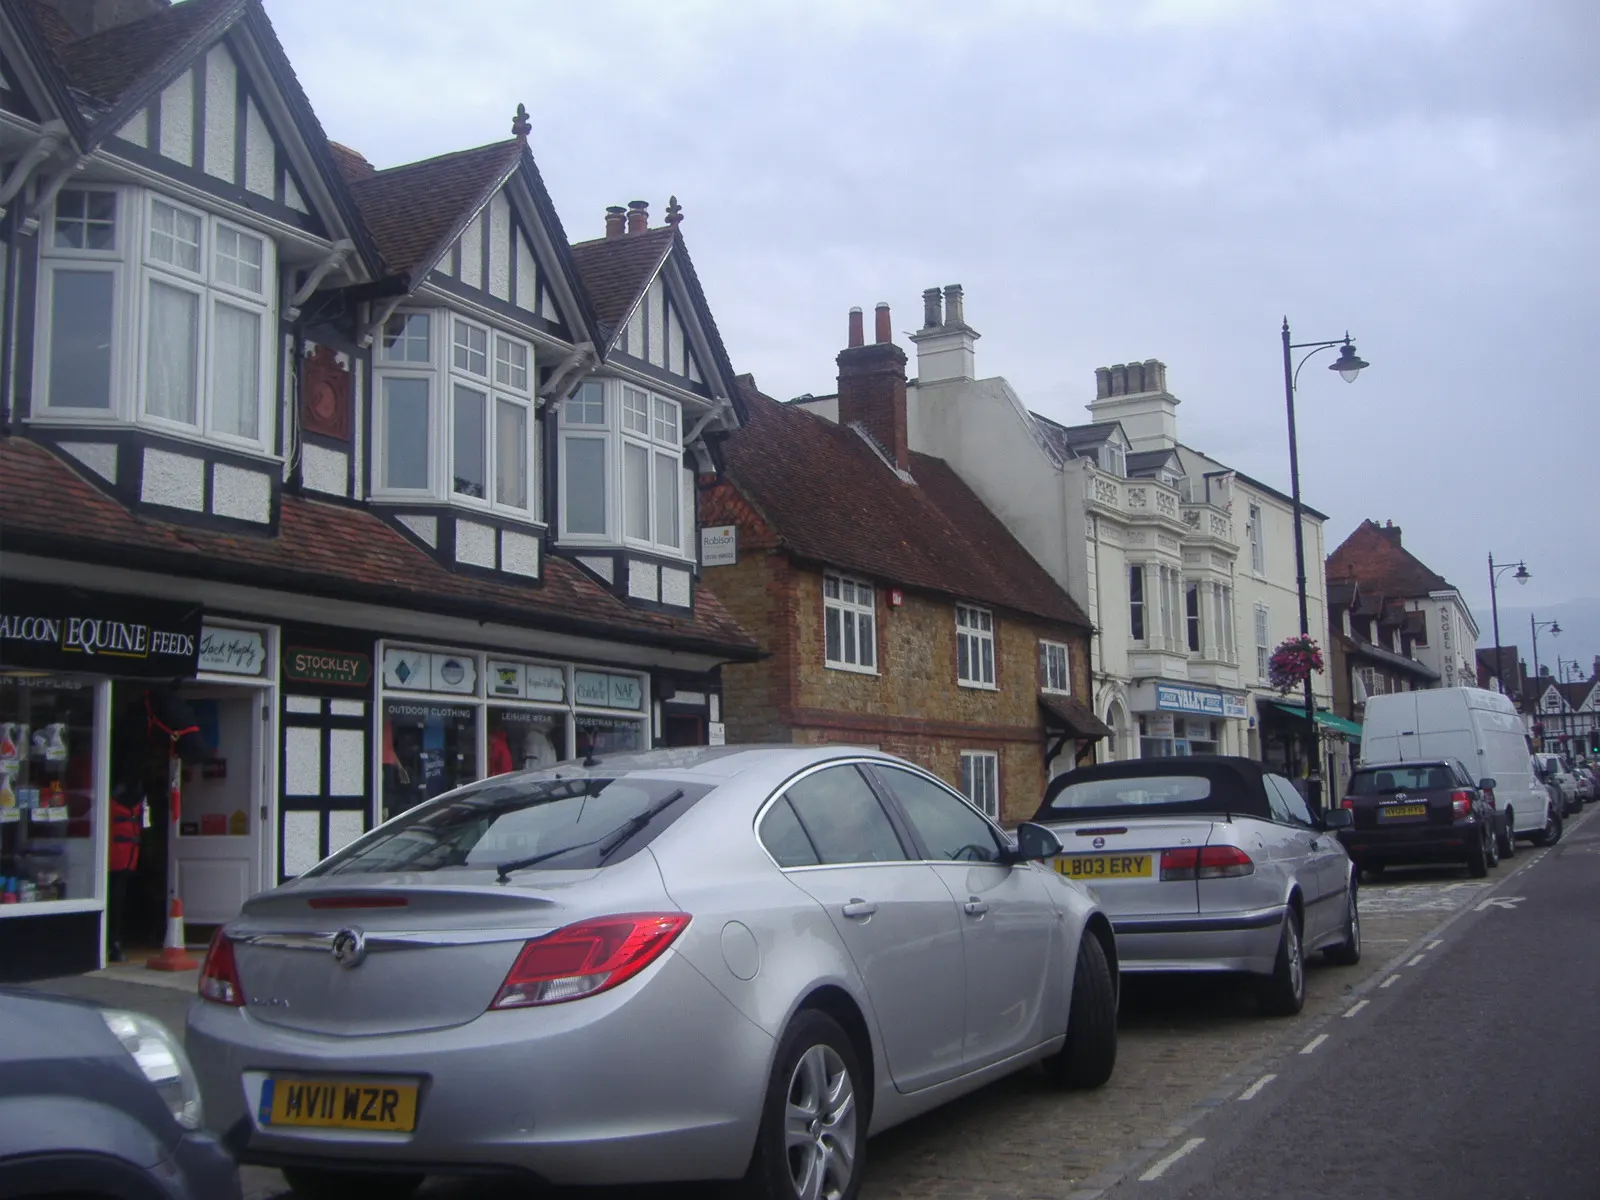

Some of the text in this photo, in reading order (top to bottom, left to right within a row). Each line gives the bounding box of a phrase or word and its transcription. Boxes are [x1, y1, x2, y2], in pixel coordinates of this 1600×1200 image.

[0, 613, 195, 656] ALCON EQUINE FEEDS
[1439, 605, 1451, 650] ANGEL
[295, 654, 359, 676] STOCKLEY
[17, 676, 82, 690] SUPPLIES
[615, 683, 634, 697] NAF
[388, 705, 471, 718] OUTDOOR CLOTHING
[501, 713, 552, 723] LEISURE WEAR
[1060, 856, 1145, 876] LB03 ERY
[342, 1087, 400, 1122] WZR
